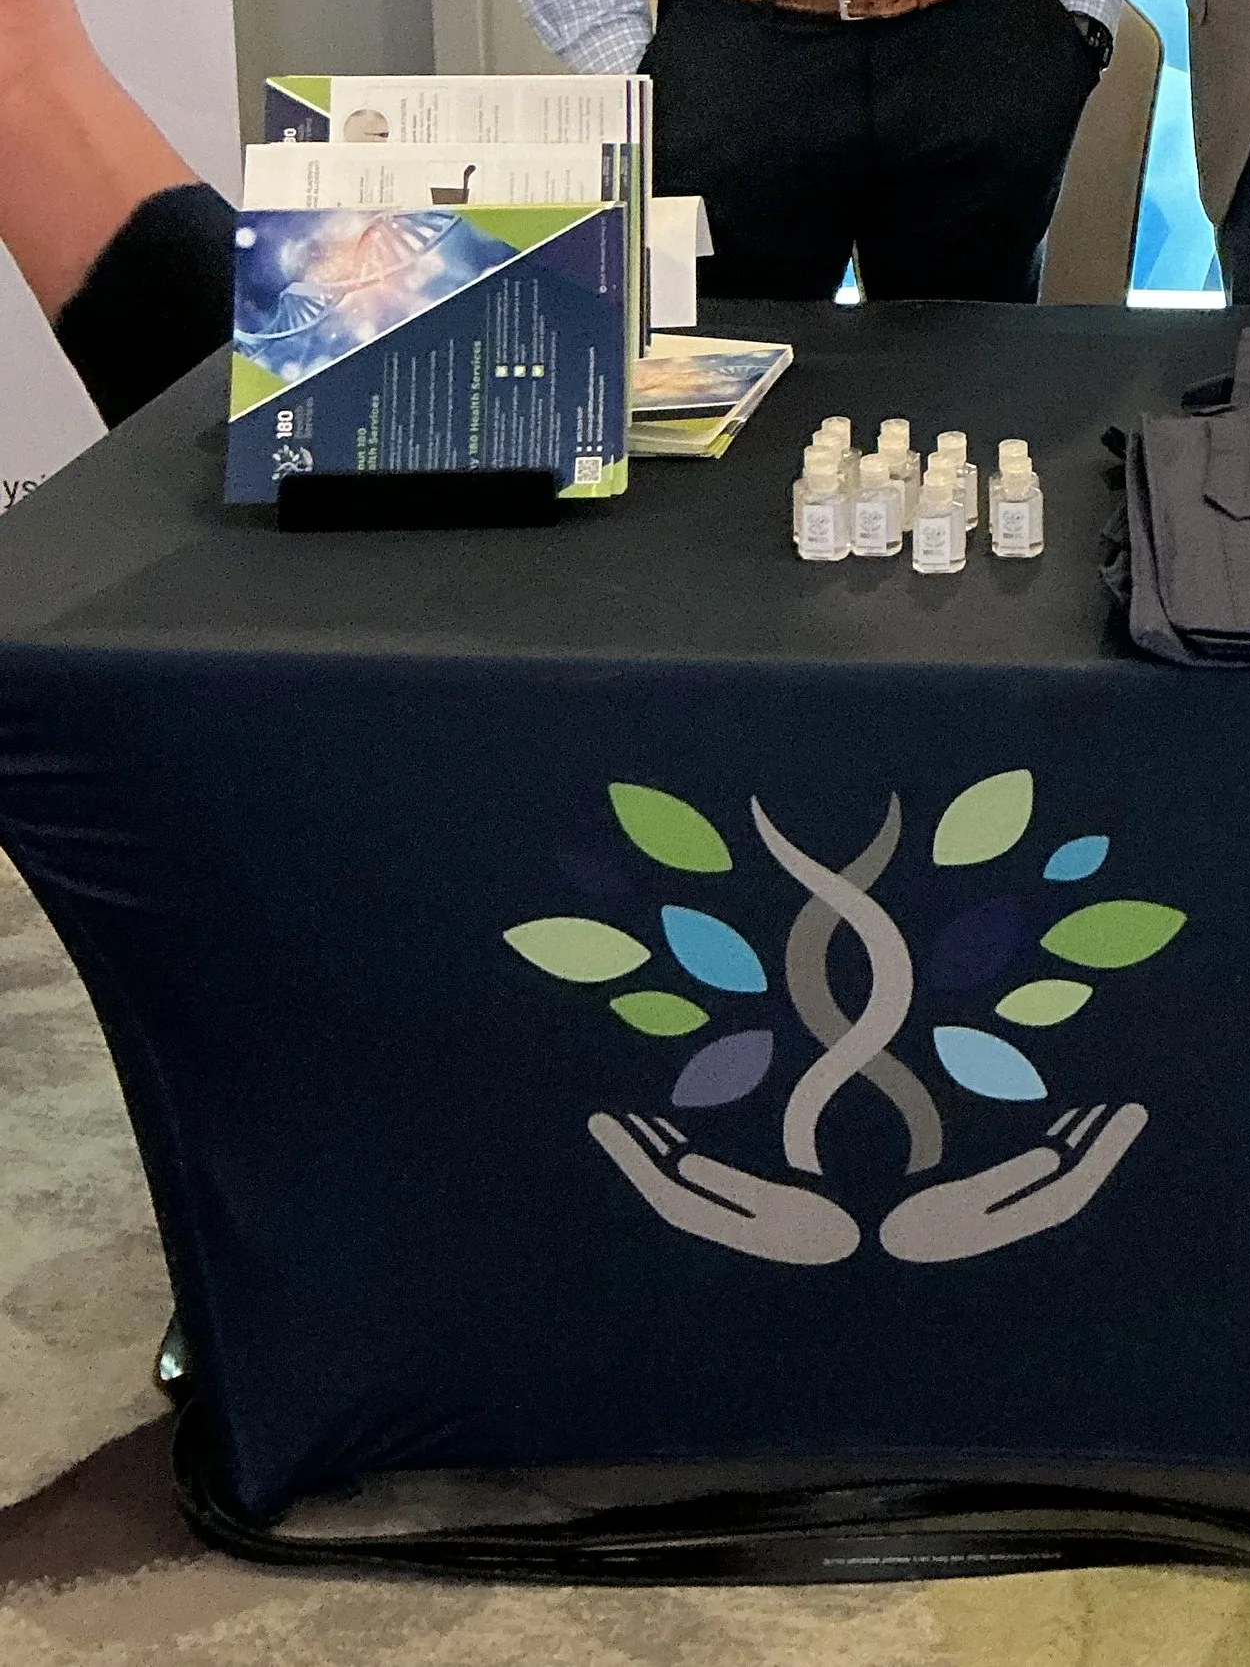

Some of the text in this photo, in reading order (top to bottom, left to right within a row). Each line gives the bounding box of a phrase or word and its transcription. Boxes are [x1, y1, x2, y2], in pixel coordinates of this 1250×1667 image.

[471, 341, 482, 391] Services
[277, 410, 294, 439] 180
[368, 394, 380, 444] Services
[469, 392, 481, 432] Health
